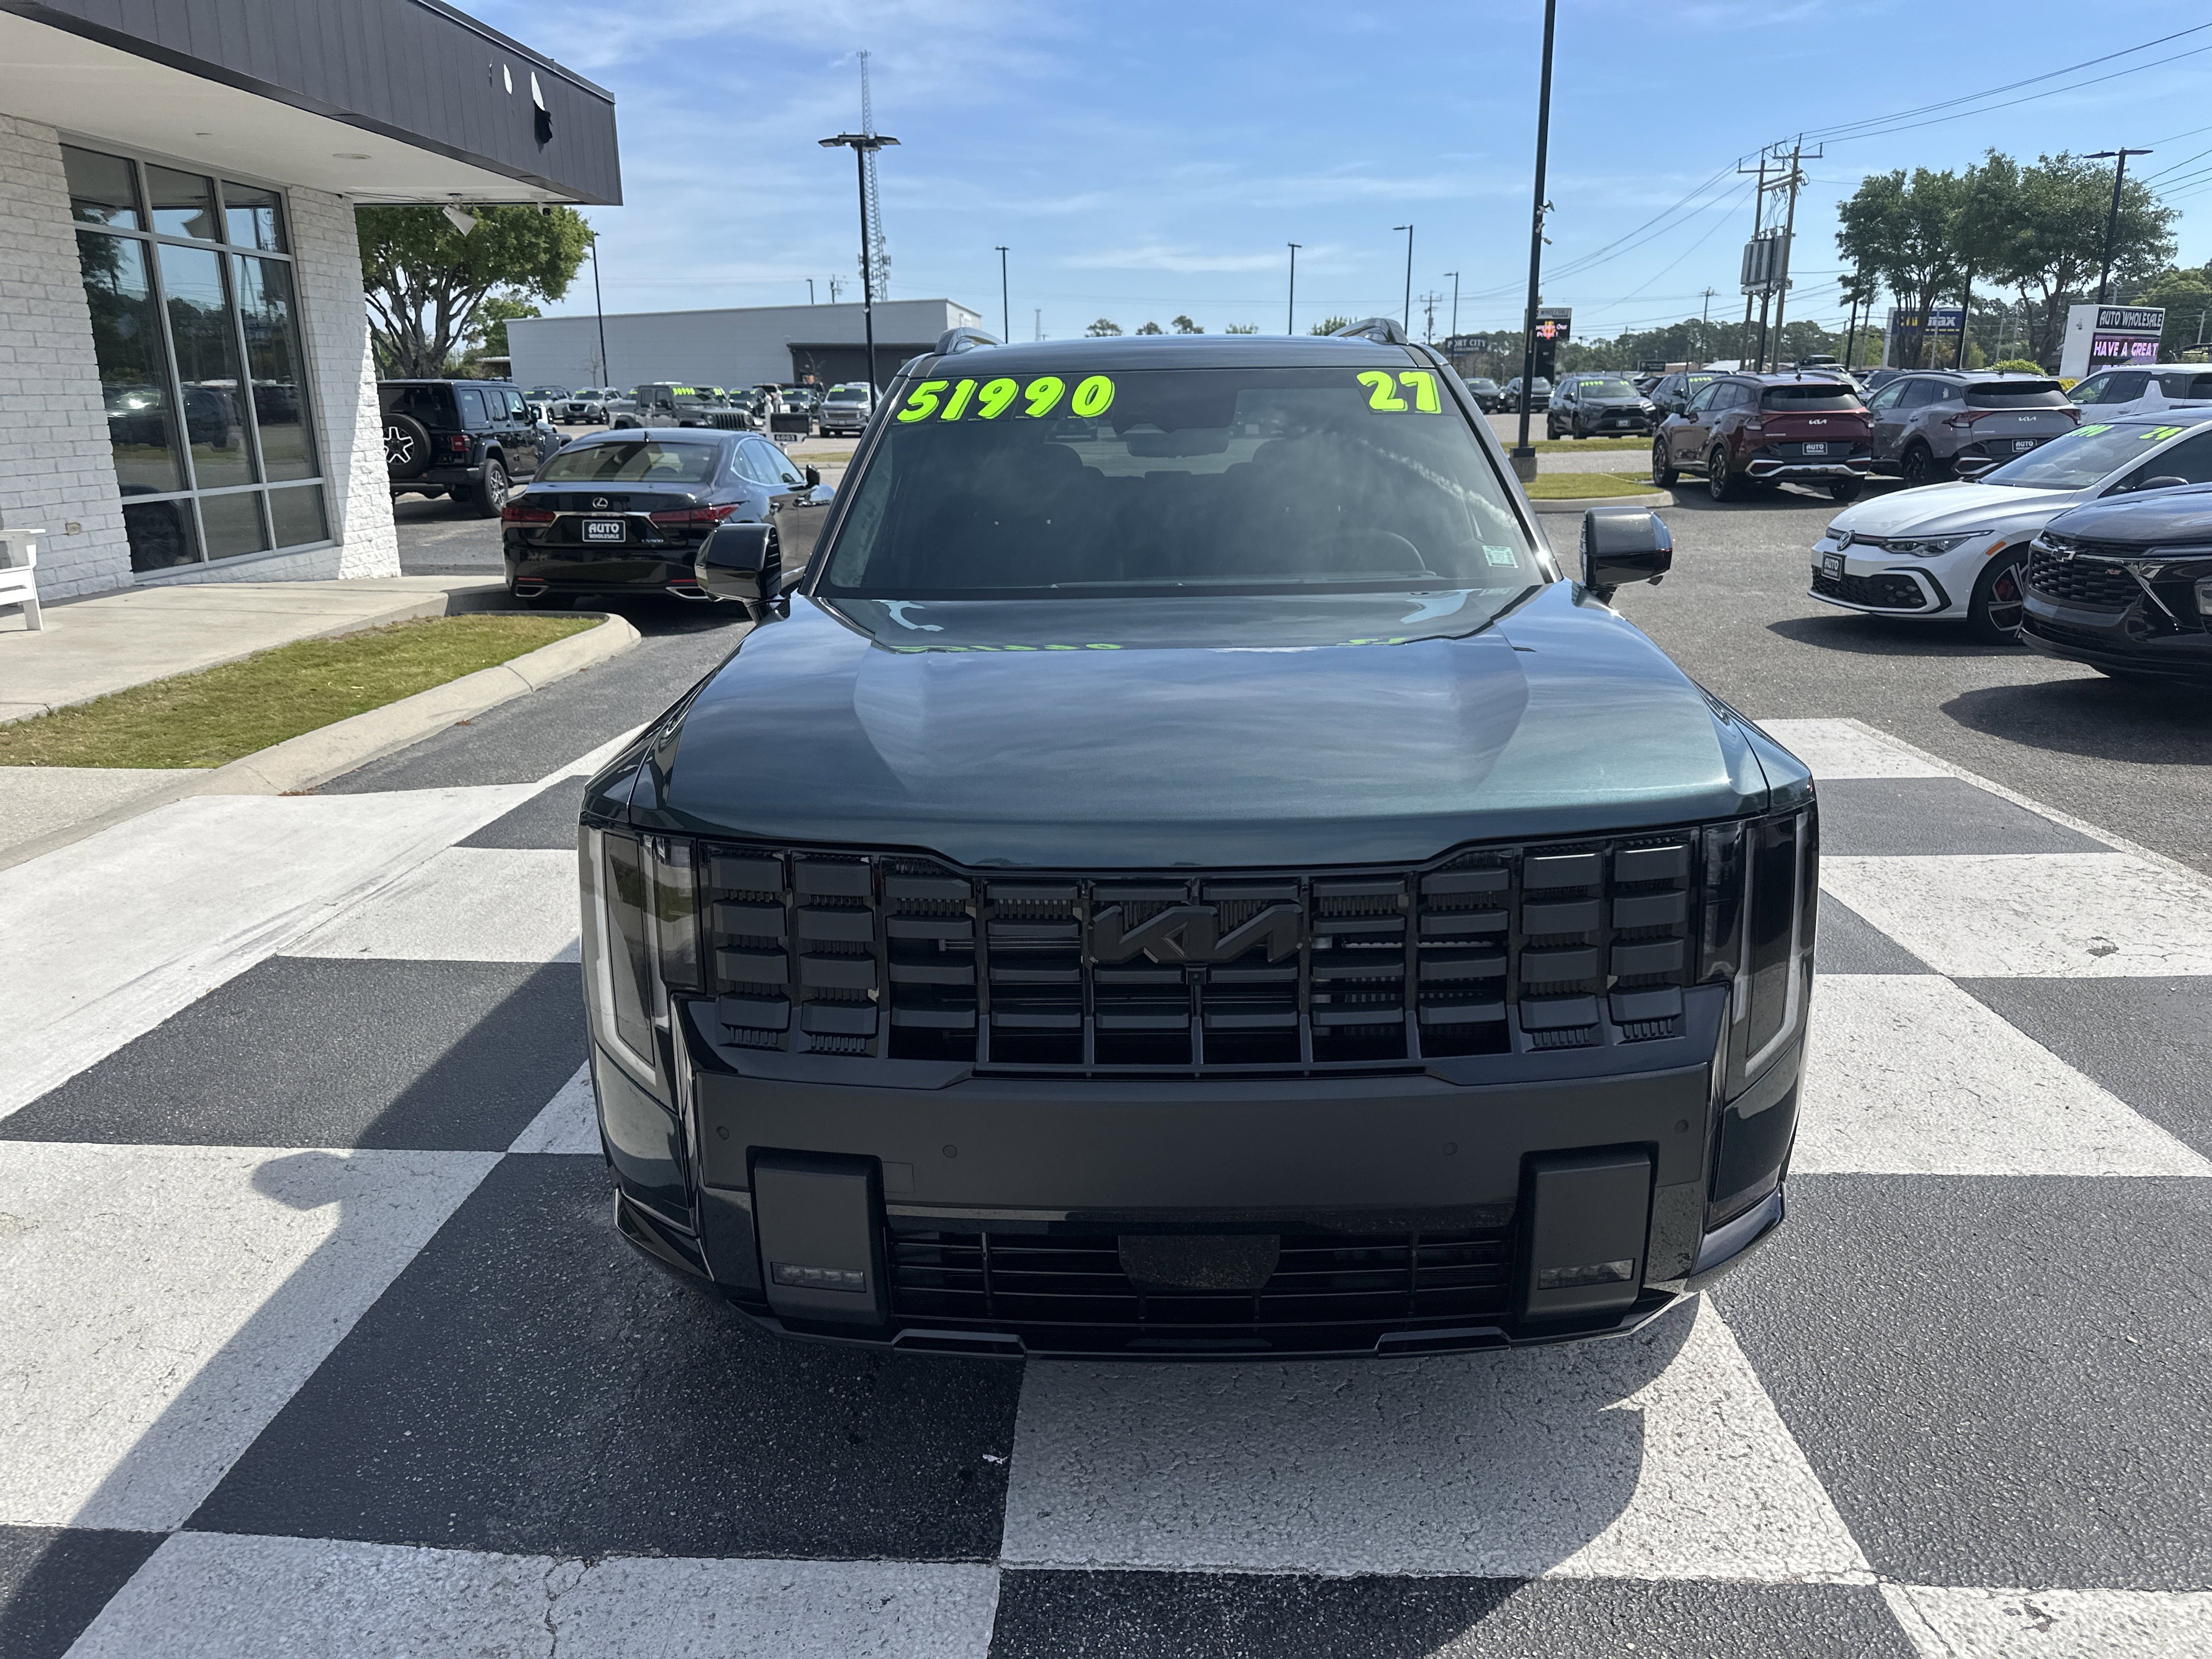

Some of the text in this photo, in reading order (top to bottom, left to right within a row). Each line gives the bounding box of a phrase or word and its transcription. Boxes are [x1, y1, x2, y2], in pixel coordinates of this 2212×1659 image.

[2099, 311, 2162, 328] AUTO WHOLESALE
[1469, 338, 1487, 347] CITY
[2094, 341, 2159, 357] HAVE A GREAT
[897, 375, 1115, 422] 51990
[1356, 371, 1442, 414] 27
[588, 523, 620, 533] AUTO
[1824, 557, 1839, 570] AUTO
